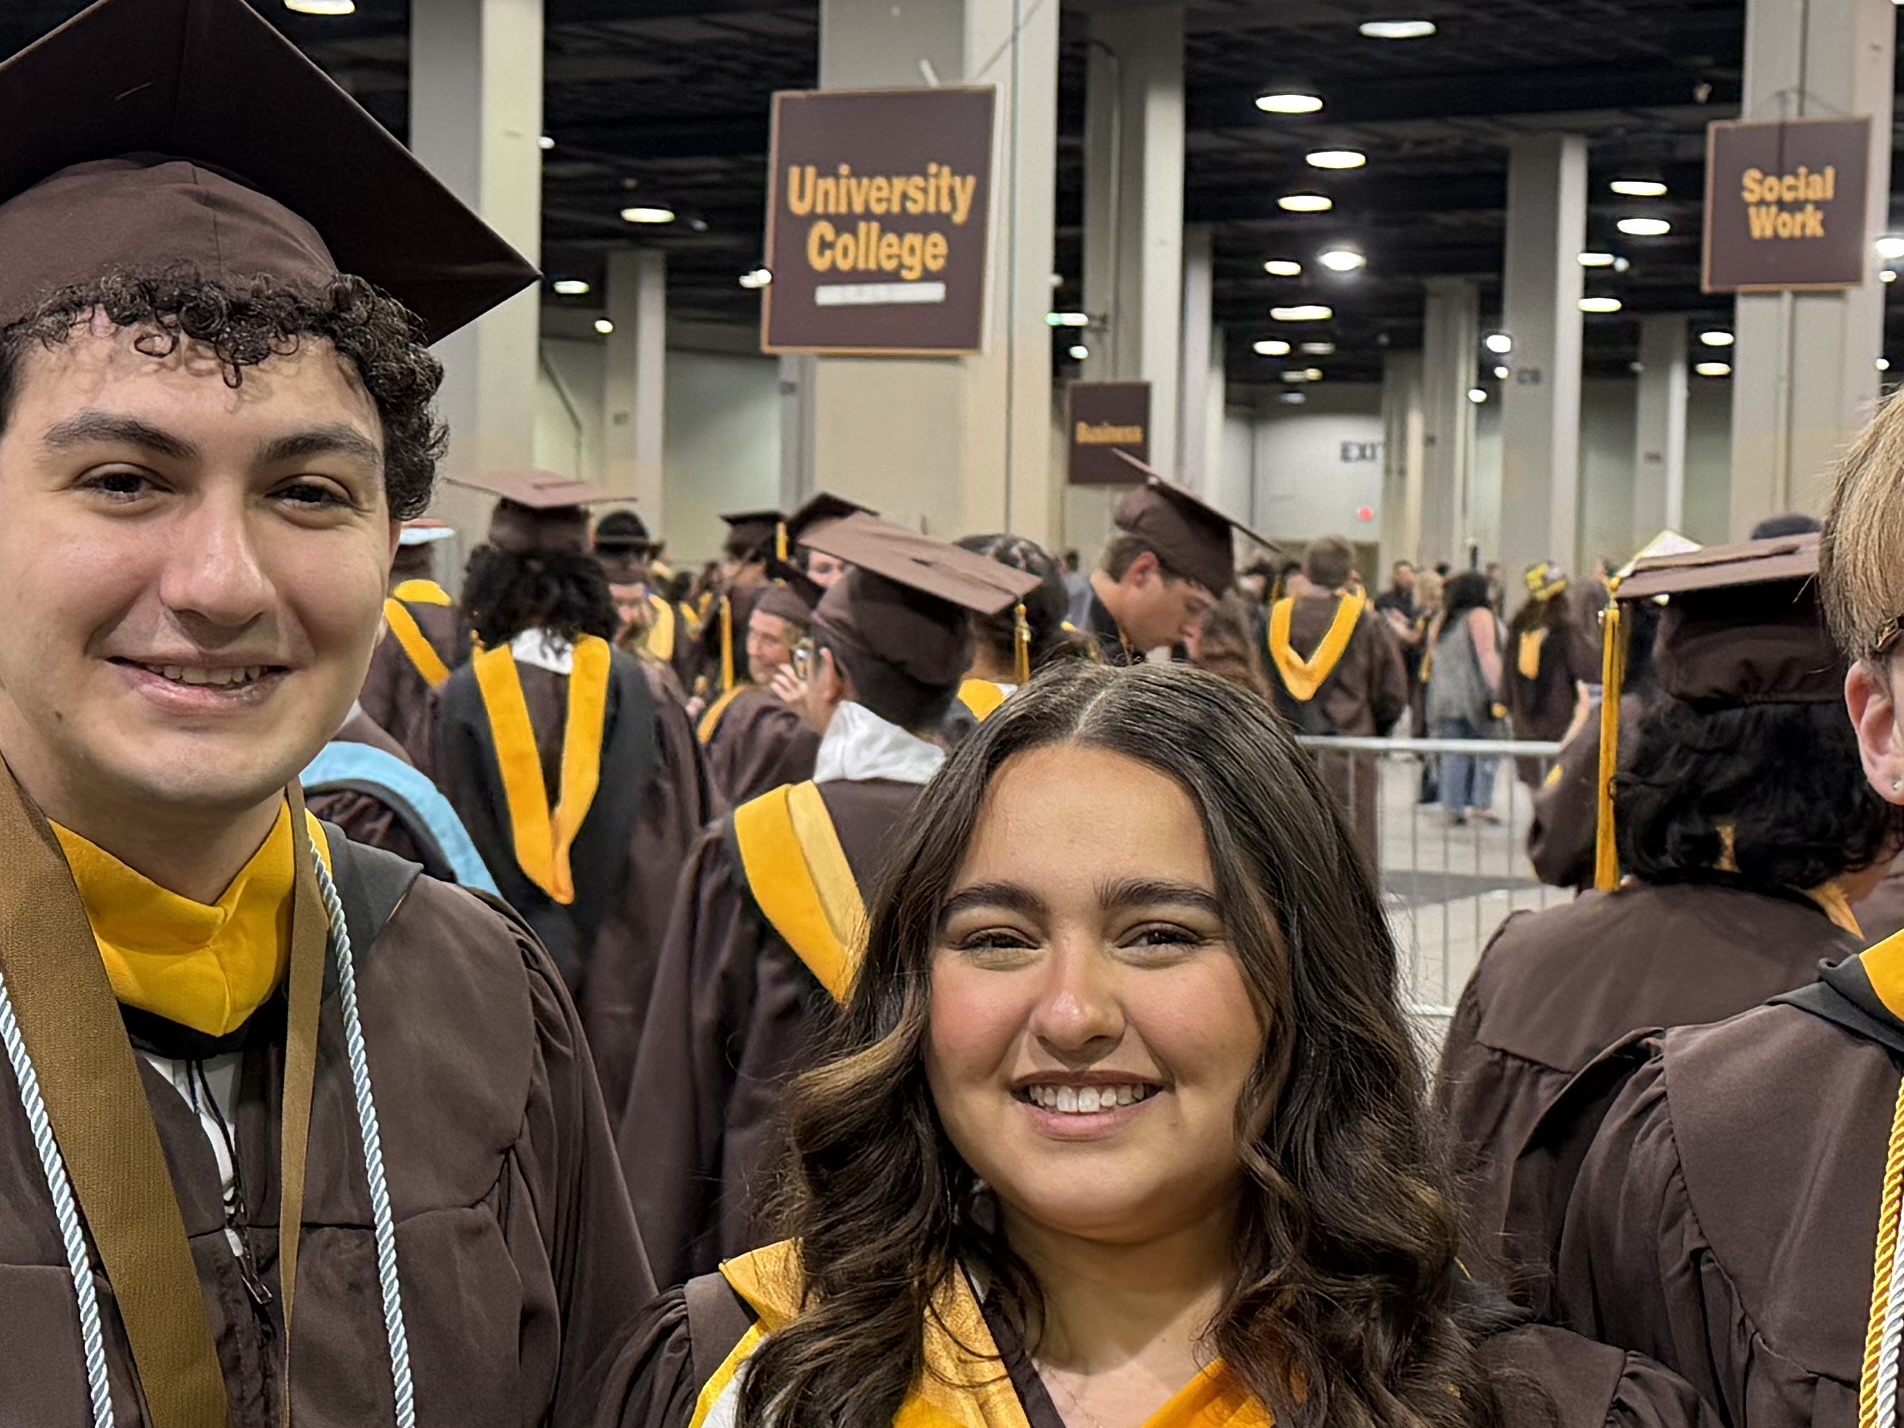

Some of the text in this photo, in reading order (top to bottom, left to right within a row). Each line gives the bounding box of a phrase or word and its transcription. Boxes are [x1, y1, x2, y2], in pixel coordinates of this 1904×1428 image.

[788, 162, 977, 226] University
[1741, 165, 1836, 204] Social
[1748, 203, 1825, 240] Work
[807, 220, 949, 281] College
